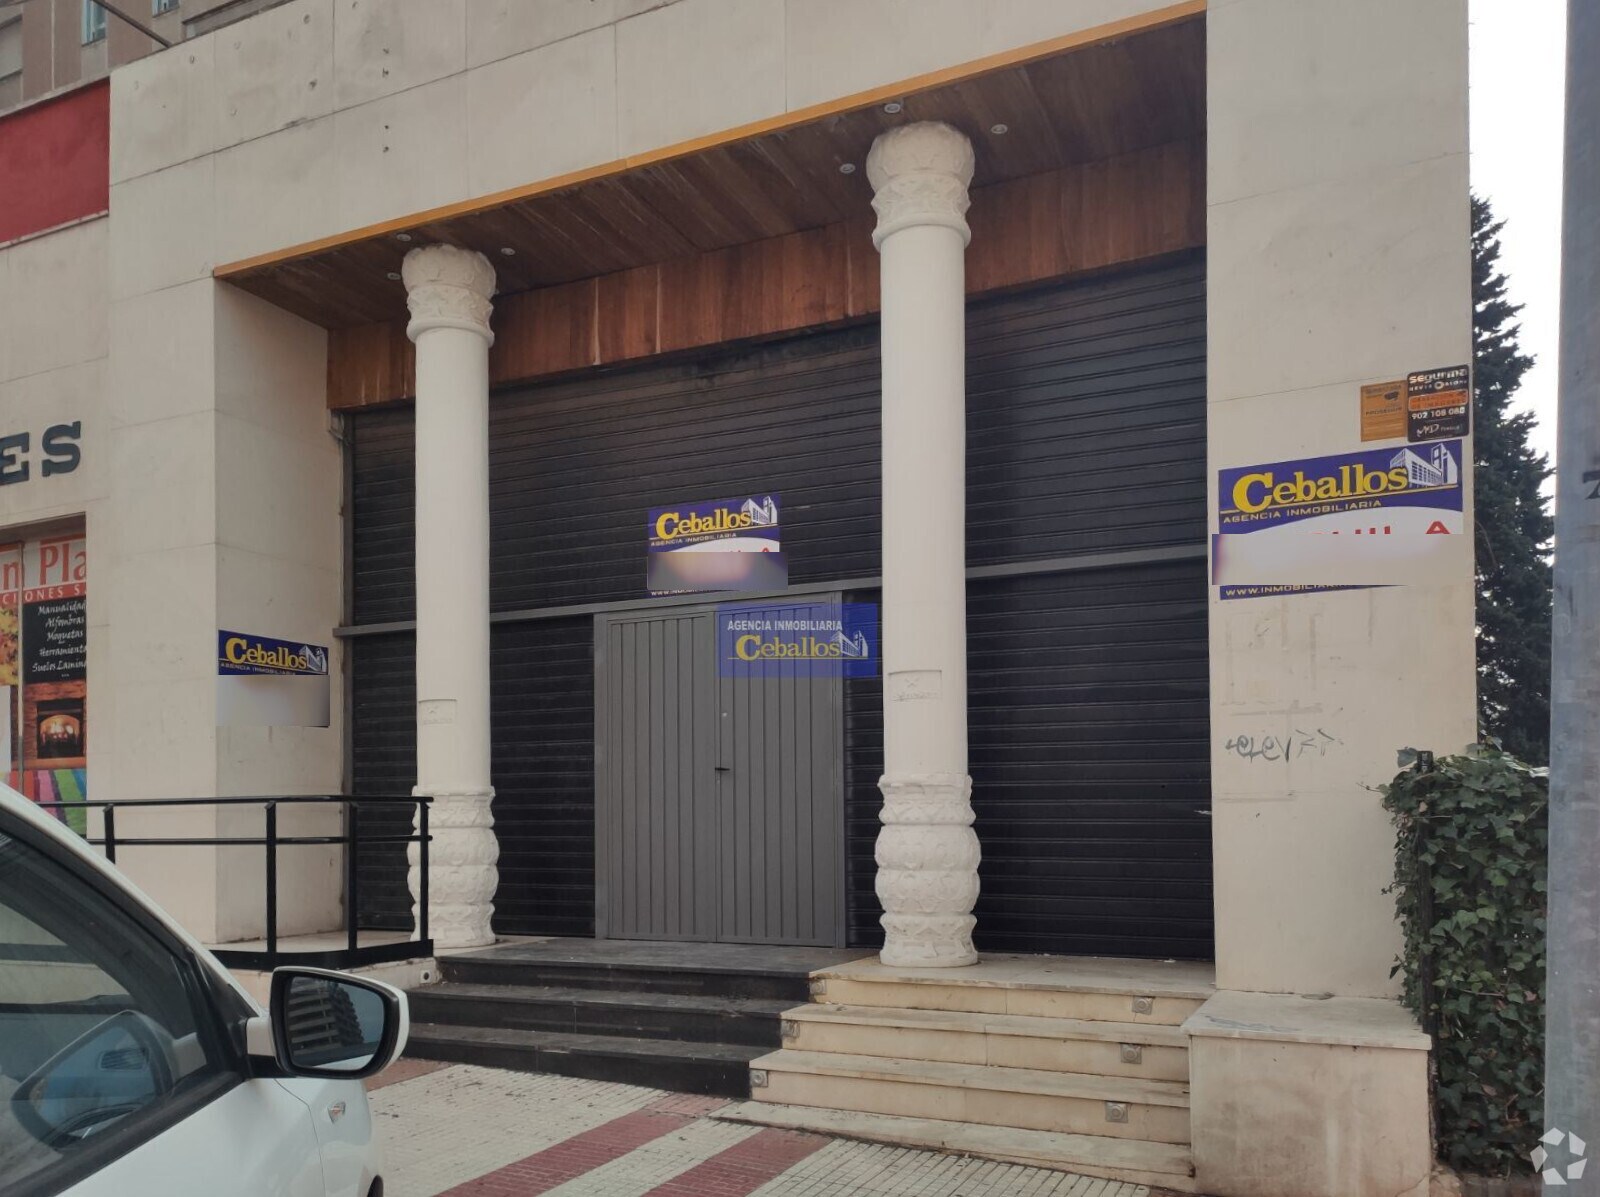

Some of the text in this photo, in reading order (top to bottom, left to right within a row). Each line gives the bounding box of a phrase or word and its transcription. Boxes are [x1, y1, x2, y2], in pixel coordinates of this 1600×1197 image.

[1411, 411, 1428, 420] 902
[1232, 464, 1408, 514] Ceballos
[656, 508, 752, 540] Ceballos
[1223, 499, 1382, 524] AGENCIA INMOBILIARIA
[651, 532, 737, 547] AGENCIA INMOBILIARIA
[225, 637, 307, 669] Ceballos
